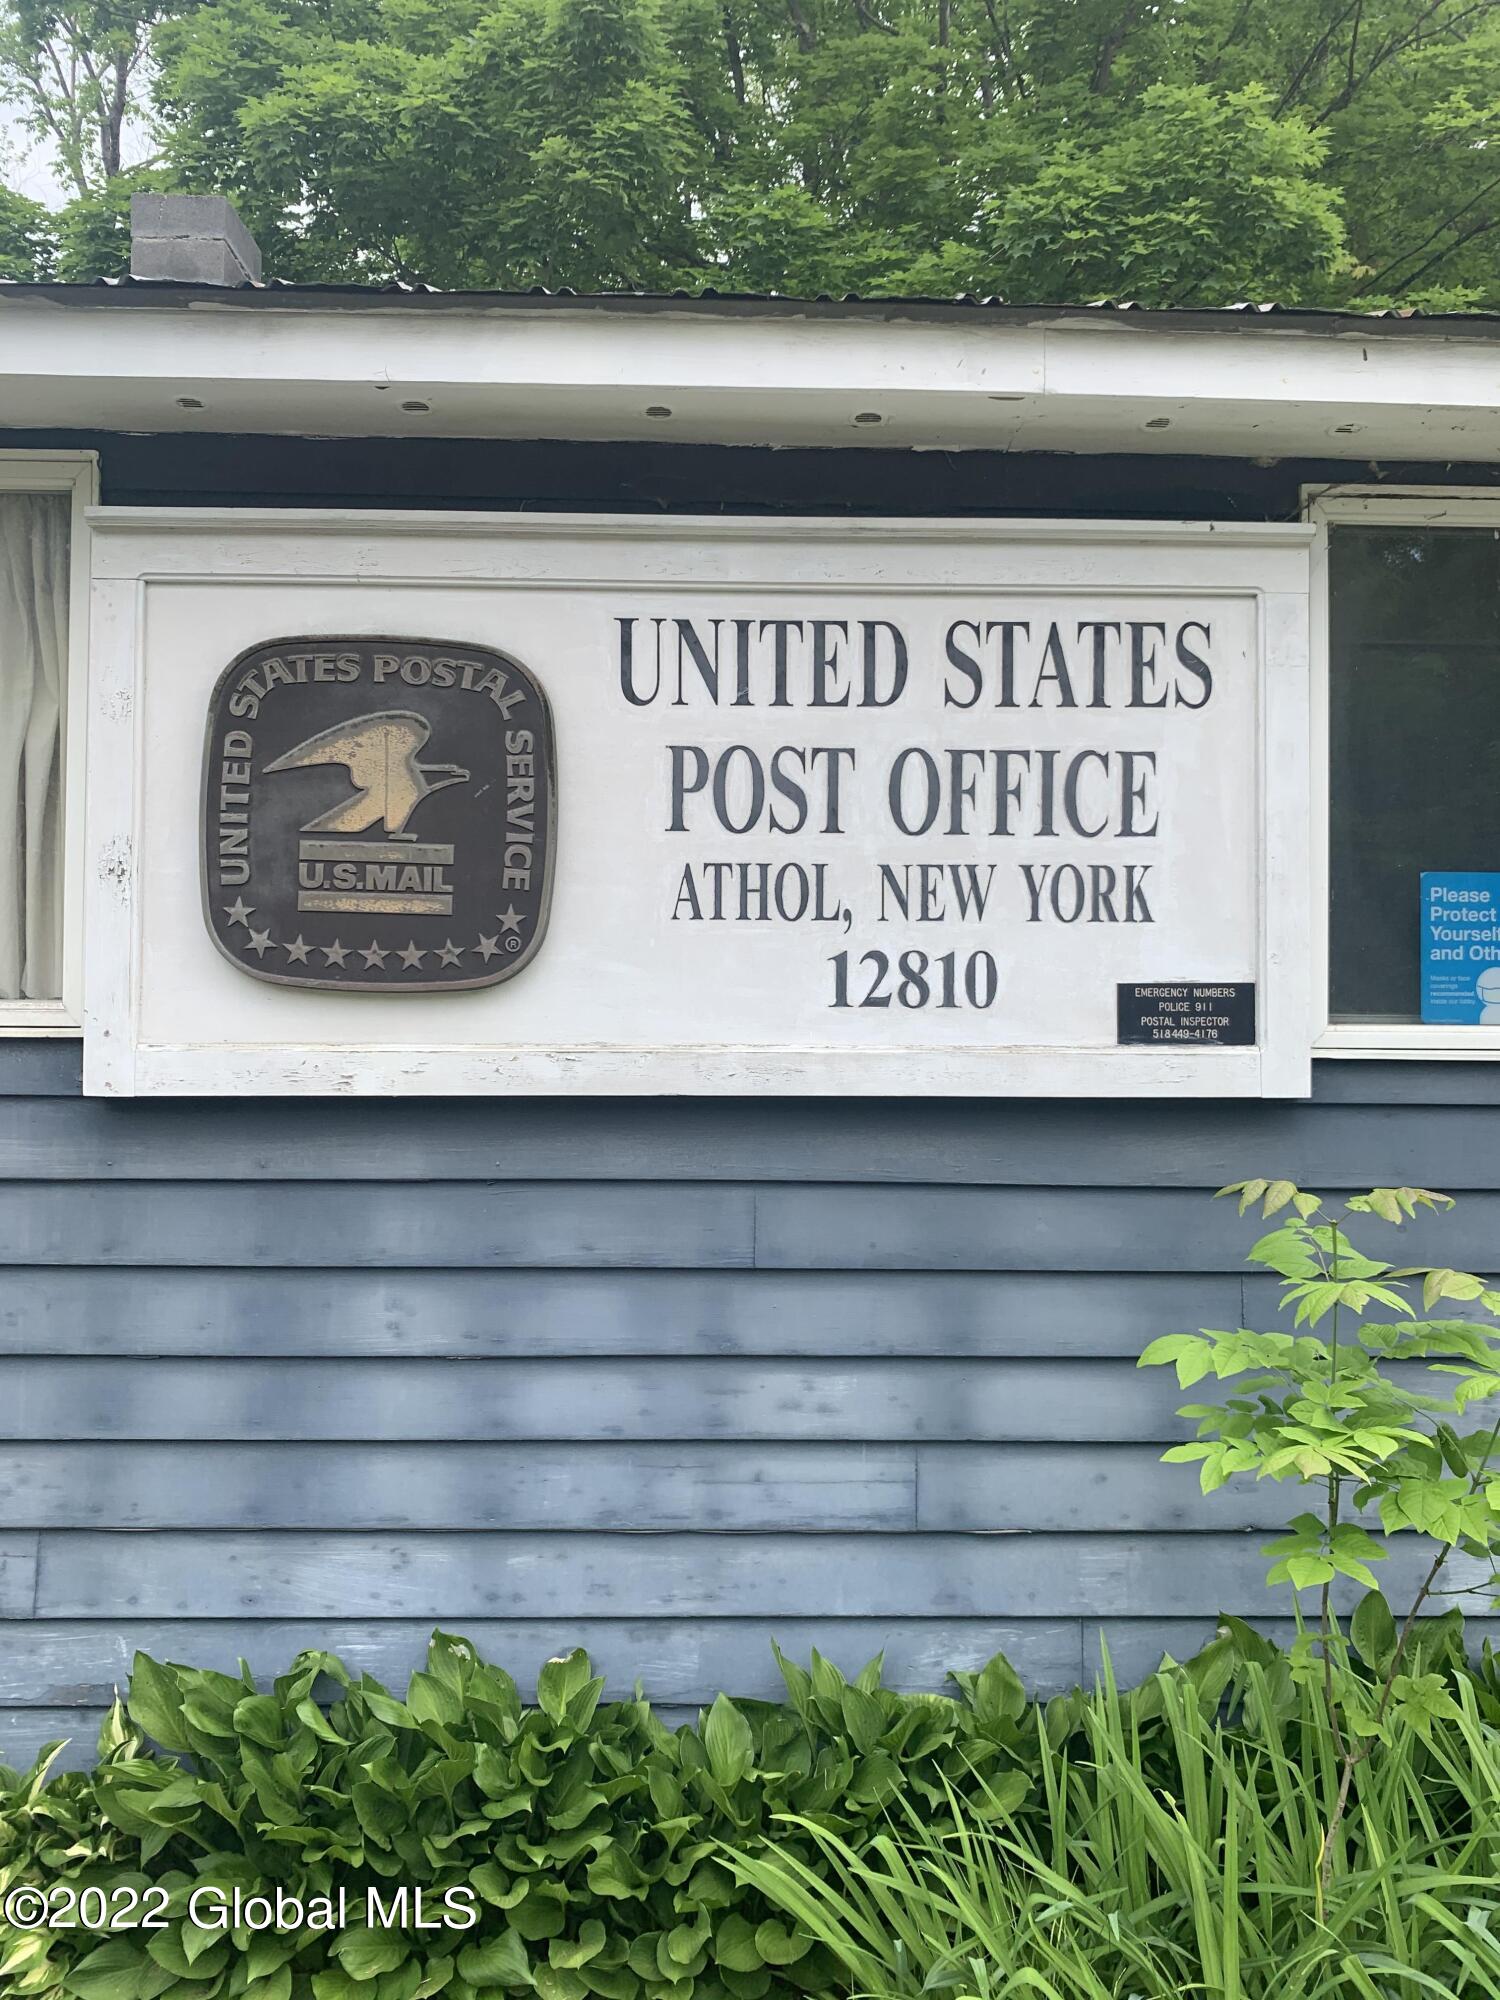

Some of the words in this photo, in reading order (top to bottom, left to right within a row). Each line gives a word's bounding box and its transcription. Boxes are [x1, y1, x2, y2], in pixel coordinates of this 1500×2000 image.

[228, 652, 361, 721] STATES
[372, 653, 528, 721] POSTAL
[616, 617, 909, 708] UNITED
[944, 620, 1213, 710] STATES
[219, 730, 254, 887] UNITED
[502, 729, 535, 892] SERVICE
[665, 745, 856, 835] POST
[888, 747, 1158, 838] OFFICE
[672, 863, 854, 934] ATHOL,
[878, 864, 997, 922] NEW
[1018, 863, 1155, 923] YORK
[1430, 887, 1491, 903] Please
[1430, 906, 1497, 922] Protect
[827, 950, 998, 1009] 12810
[1430, 945, 1464, 961] and
[1135, 987, 1188, 998] EMERGENCY
[1193, 987, 1236, 998] NUMBERS
[1141, 1016, 1175, 1026] POSTAL
[1180, 1016, 1230, 1026] INSPECTOR
[1158, 1002, 1190, 1012] POLICE
[1195, 1002, 1212, 1012] 911
